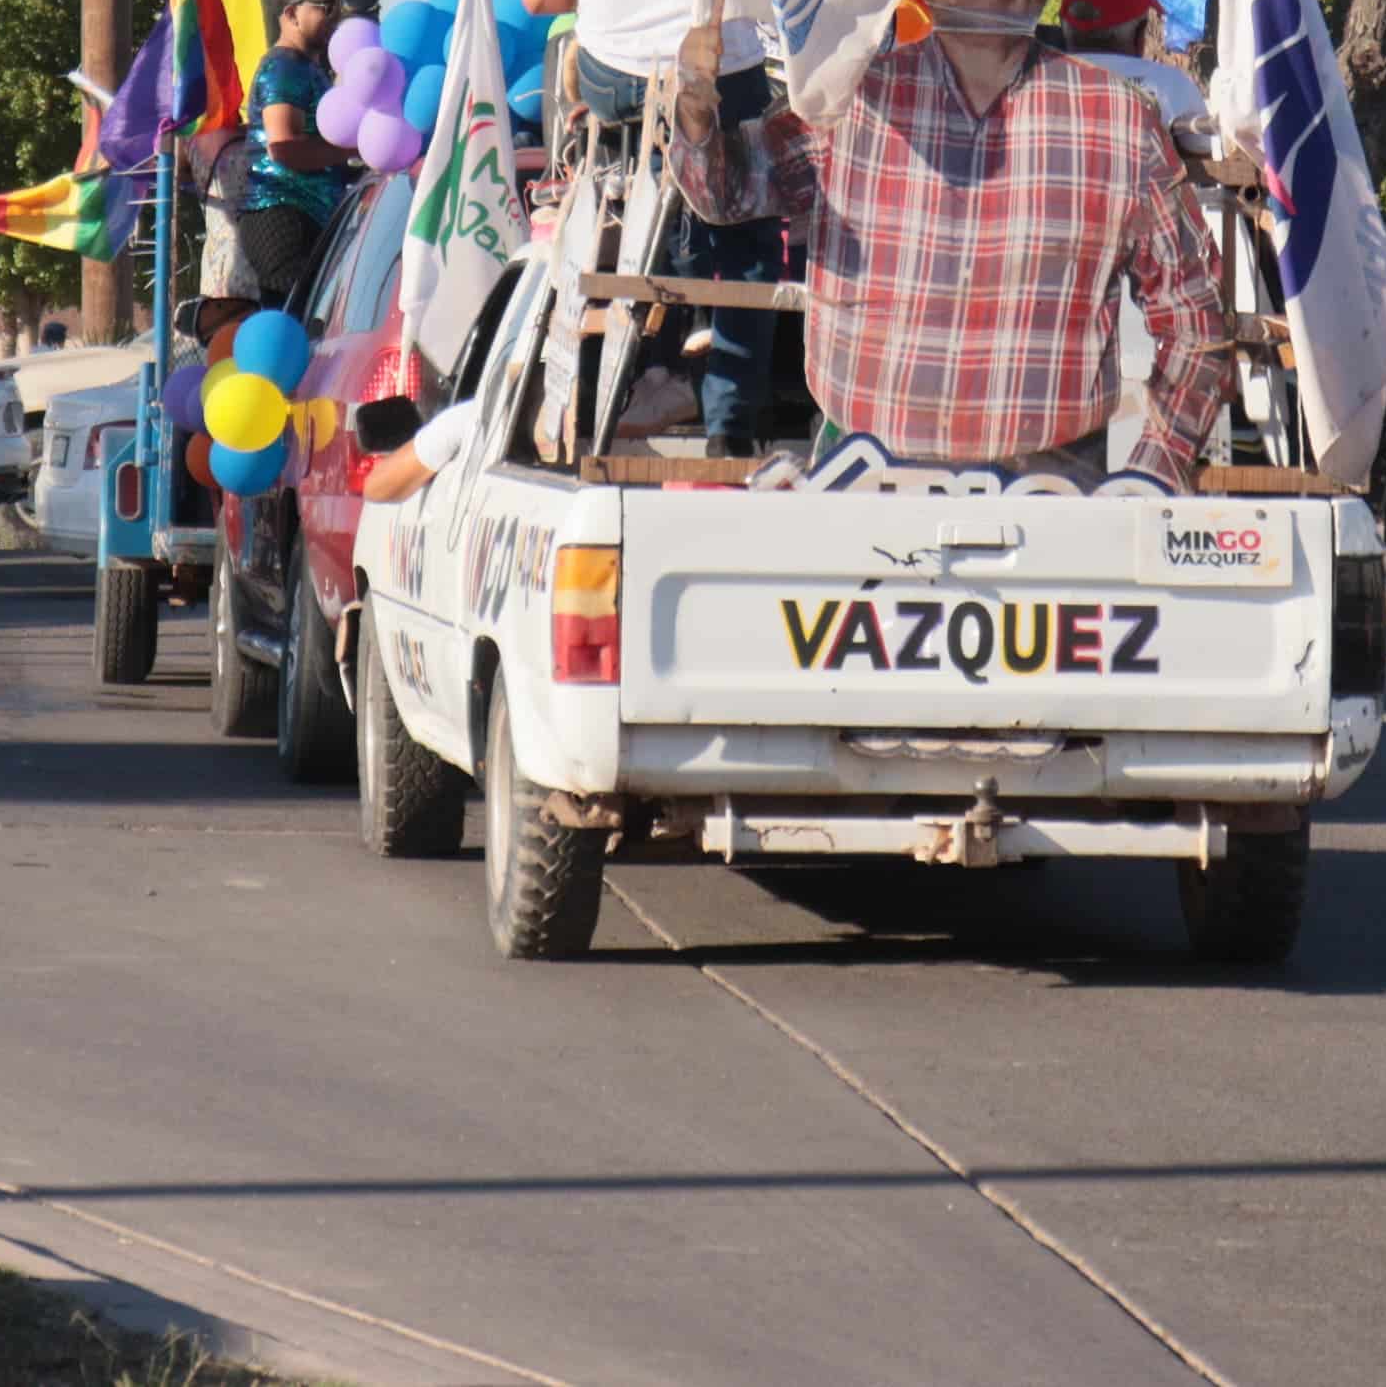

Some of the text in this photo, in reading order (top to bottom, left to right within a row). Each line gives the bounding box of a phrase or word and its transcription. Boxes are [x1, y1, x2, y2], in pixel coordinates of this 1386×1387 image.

[1166, 529, 1262, 551] MINGO
[1167, 552, 1261, 568] VAZQUEZ
[780, 579, 1160, 684] VÁZQUEZ
